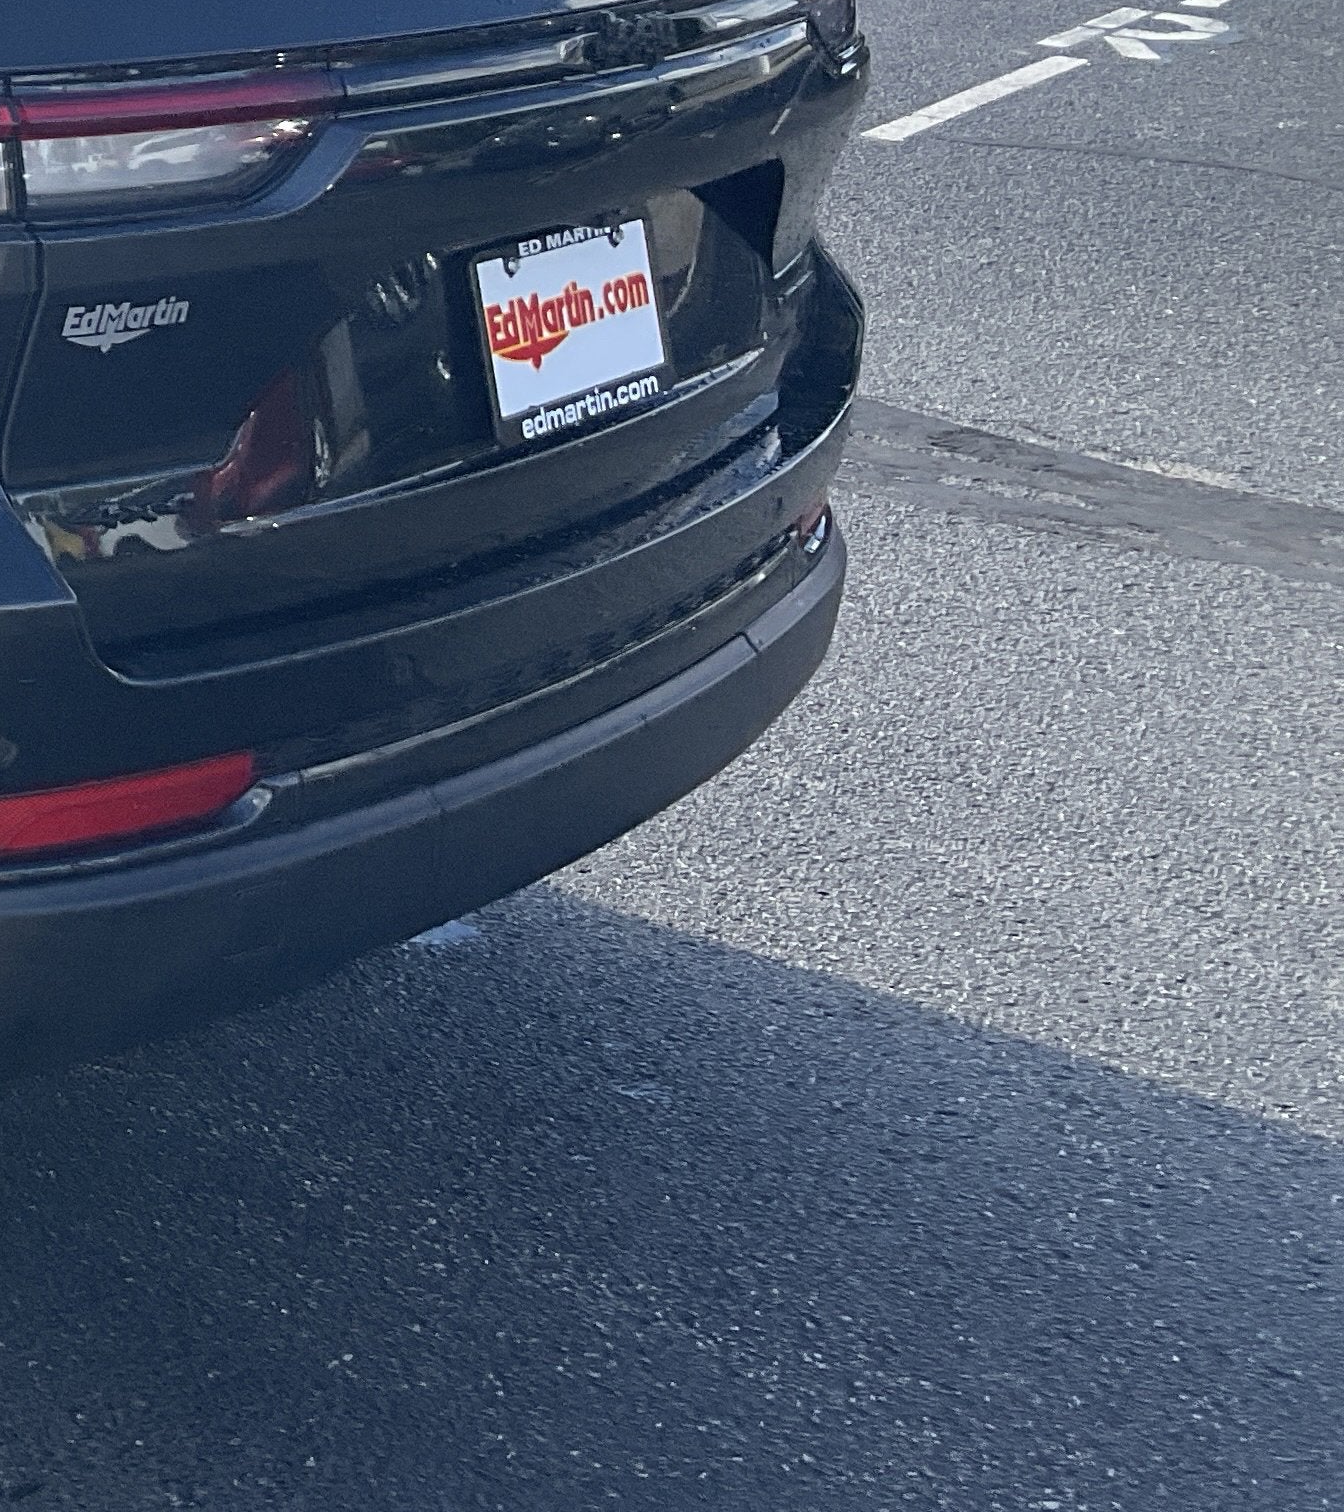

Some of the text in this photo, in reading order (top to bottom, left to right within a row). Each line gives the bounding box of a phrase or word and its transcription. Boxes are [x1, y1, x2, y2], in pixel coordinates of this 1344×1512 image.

[518, 238, 542, 257] ED
[62, 296, 190, 338] EdMartin
[521, 375, 659, 439] edmartin.com
